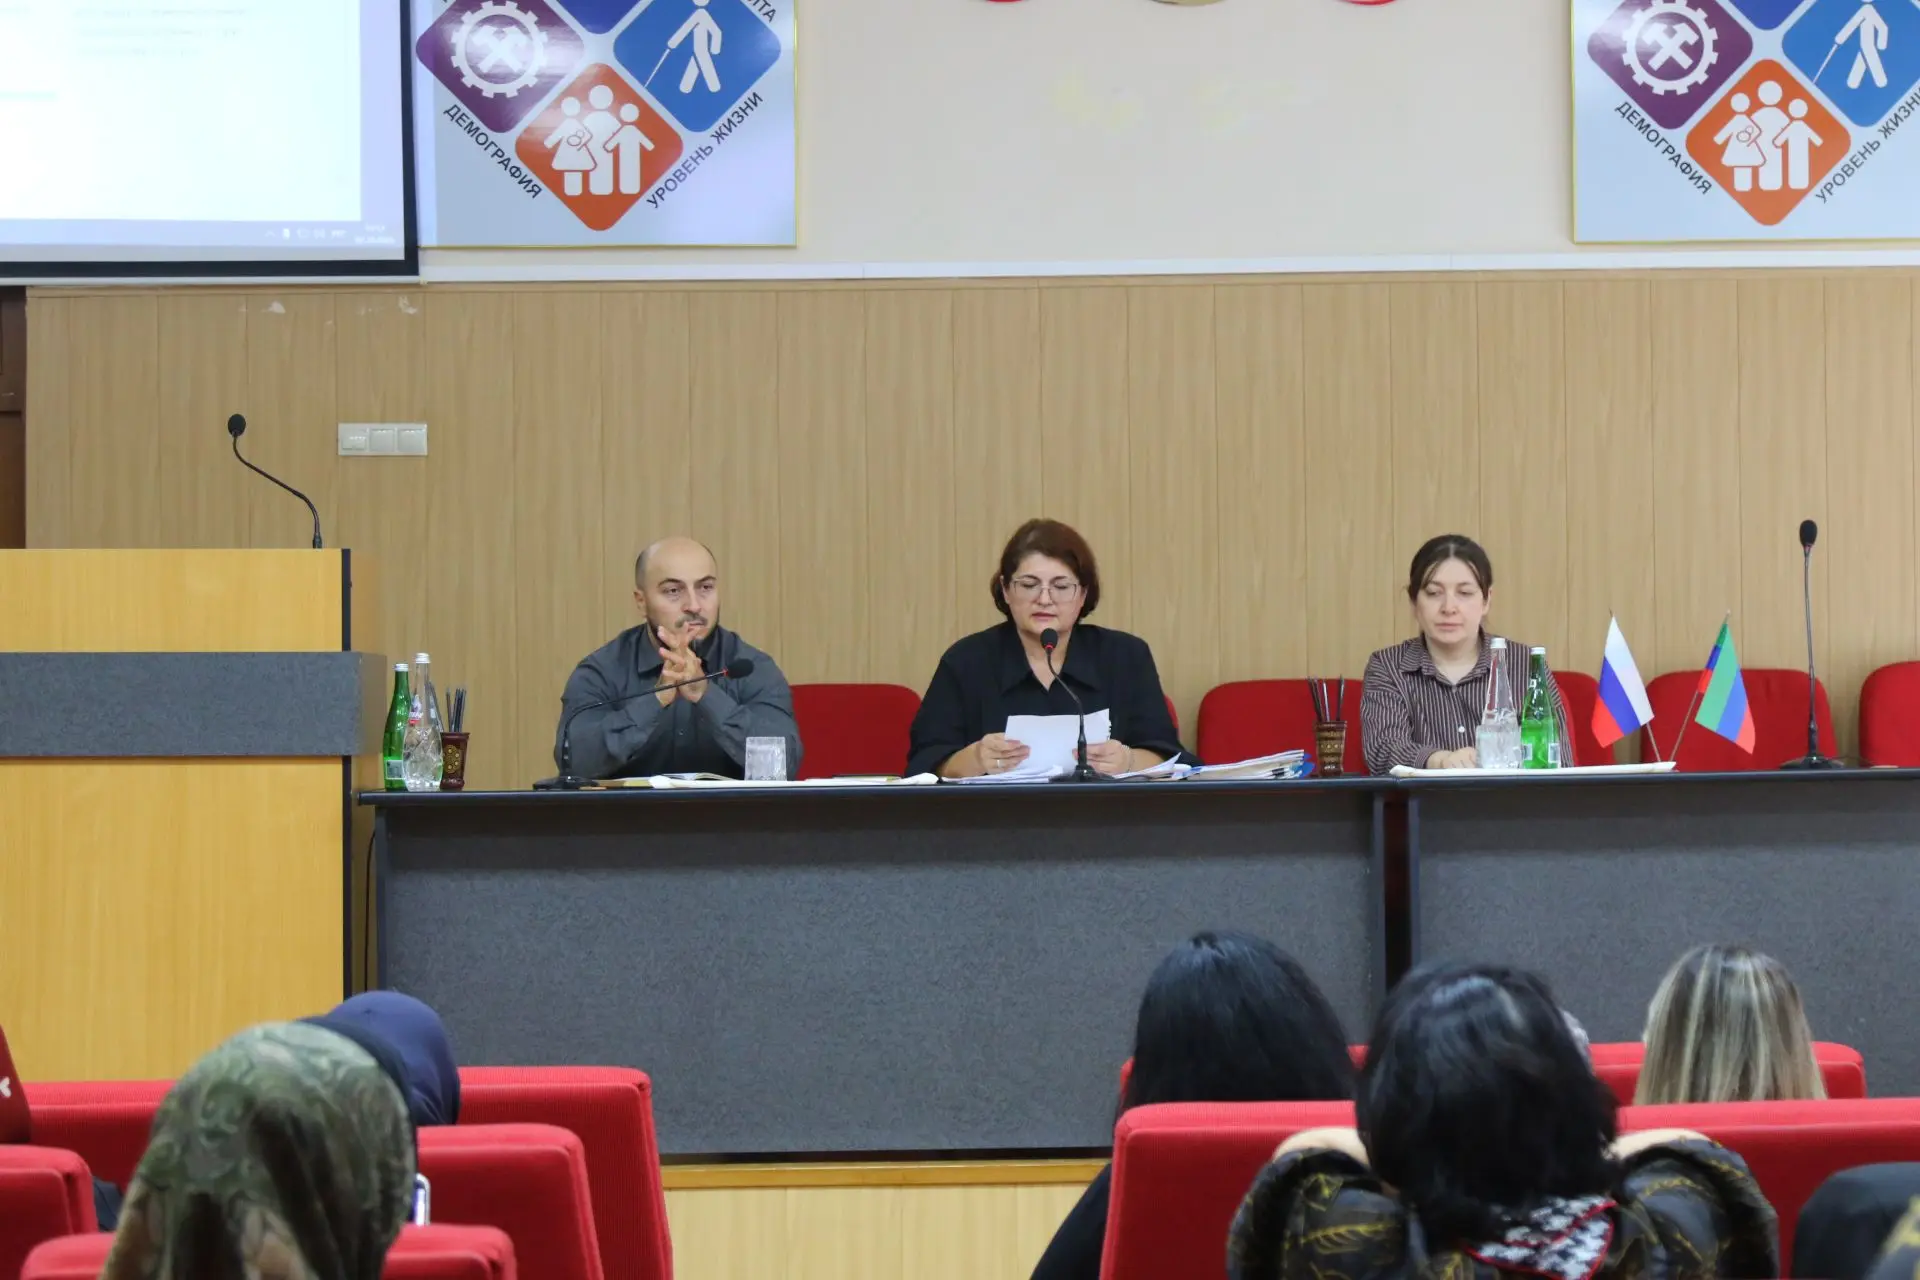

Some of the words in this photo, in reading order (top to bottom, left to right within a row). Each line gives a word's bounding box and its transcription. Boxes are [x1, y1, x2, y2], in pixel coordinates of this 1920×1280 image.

[443, 104, 542, 199] ДЕМОГРАФИЯ
[646, 144, 713, 208] УРОВЕНЬ
[710, 91, 763, 144] ЖИЗНИ
[1614, 101, 1712, 194] ДЕМОГРАФИЯ
[1815, 140, 1881, 204] УРОВЕНЬ
